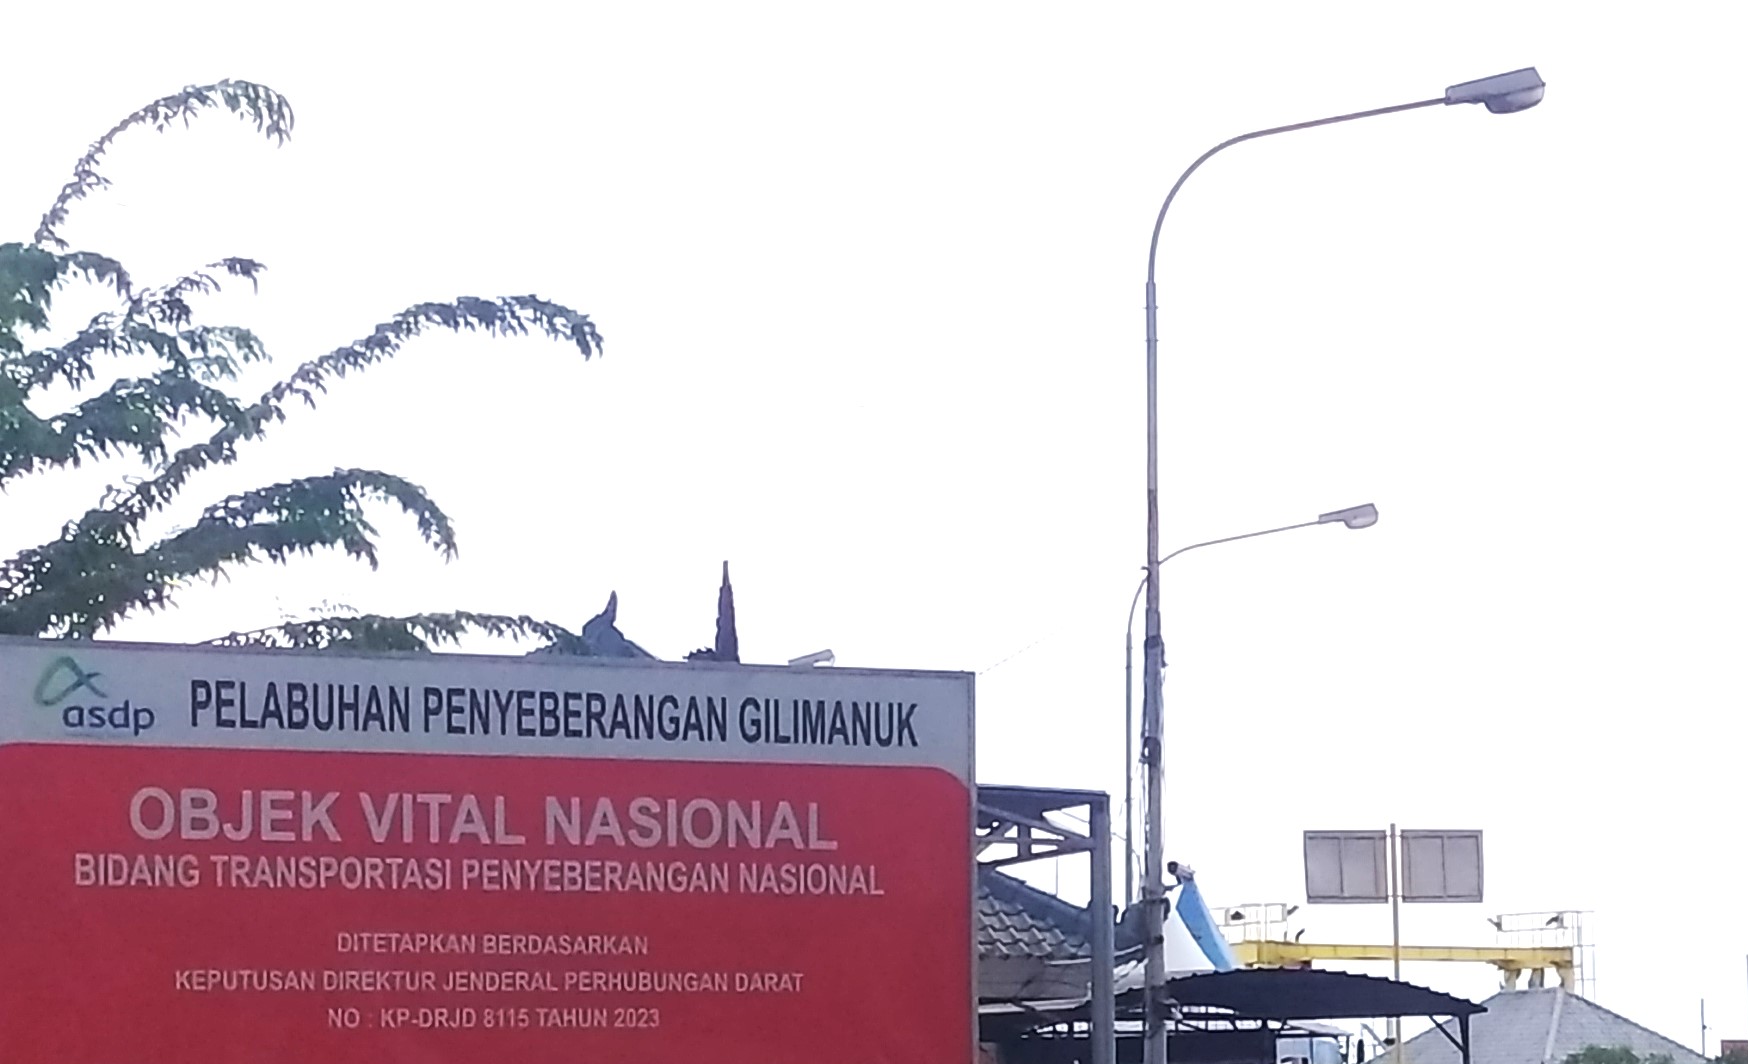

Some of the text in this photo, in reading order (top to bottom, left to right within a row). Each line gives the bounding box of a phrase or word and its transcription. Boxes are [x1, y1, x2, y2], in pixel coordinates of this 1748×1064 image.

[62, 699, 155, 736] asdp
[191, 680, 918, 747] PELABUHAN PENYEBERANGAN GILIMANUK
[130, 787, 837, 849] OBJEK VITAL NASIONAL
[75, 854, 884, 894] BIDANG TRANSPORTASI PENYEBERANGAN NASIONAL
[338, 933, 647, 955] DITETAPKAN BERDASARKAN
[176, 970, 803, 991] KEPUTUSAN DIREKTUR JENDERAL PERHUBUNGAN DARAT
[329, 1008, 360, 1028] NO
[381, 1008, 476, 1028] KP-DRJD
[483, 1008, 529, 1028] 8115
[536, 1008, 607, 1027] TAHUN
[614, 1008, 659, 1027] 2023
